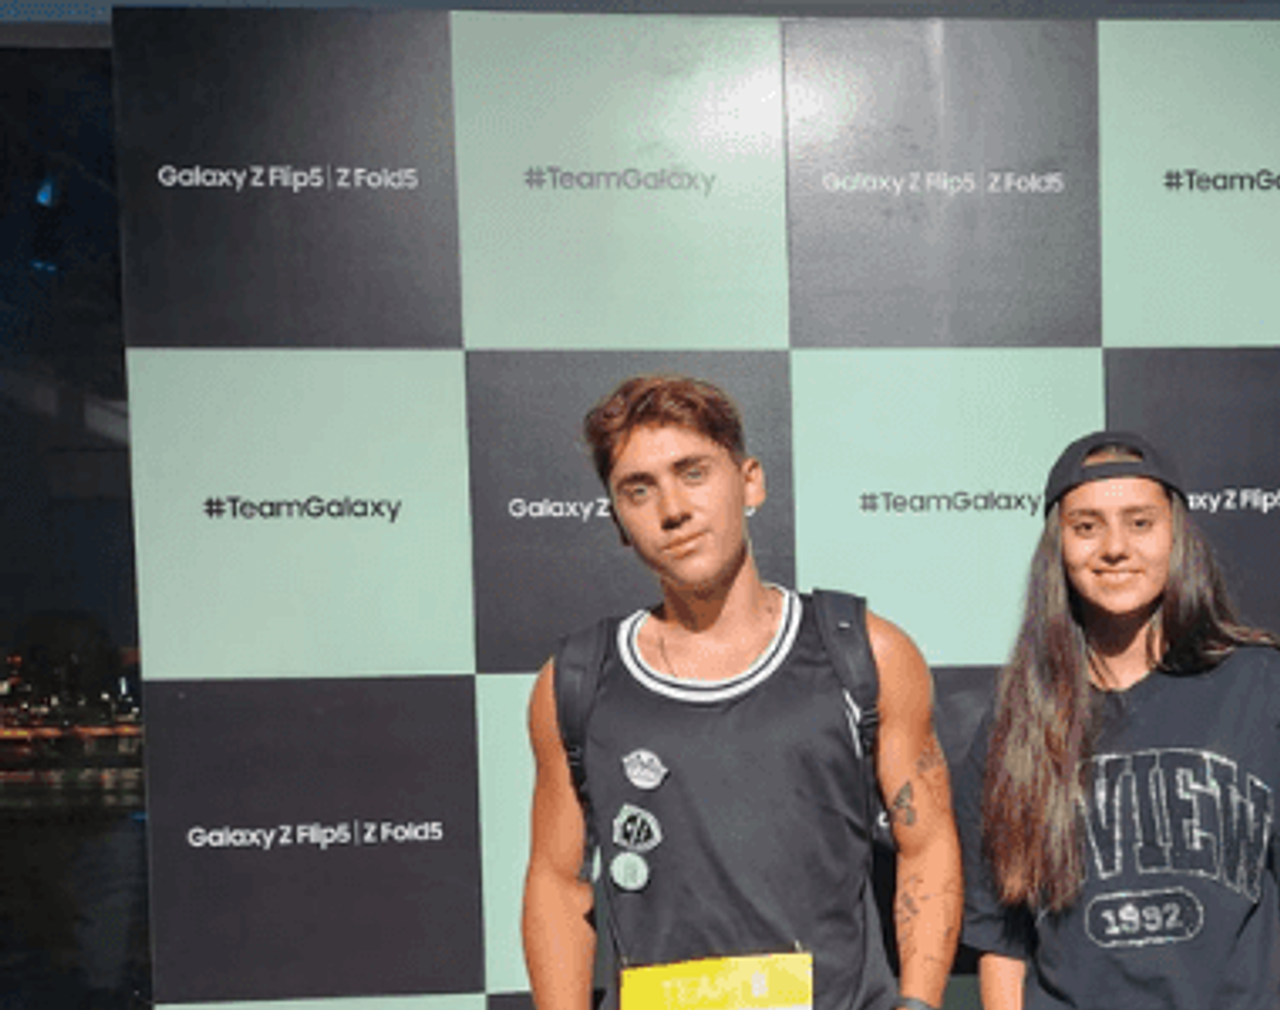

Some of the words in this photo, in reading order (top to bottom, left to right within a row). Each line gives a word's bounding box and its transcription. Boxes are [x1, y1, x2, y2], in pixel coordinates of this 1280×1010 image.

[158, 166, 247, 191] Galaxy
[251, 166, 264, 186] Z
[269, 166, 323, 192] Flip5
[337, 168, 350, 187] Z
[354, 168, 418, 189] Fold5
[525, 167, 716, 197] #TeamGalaxy
[822, 171, 905, 196] Galaxy
[909, 172, 921, 191] Z
[926, 171, 976, 195] Flip5
[988, 172, 1000, 191] Z
[1004, 171, 1064, 192] Fold5
[204, 496, 401, 522] #TeamGalaxy
[509, 498, 594, 521] Galaxy
[860, 490, 1042, 517] #TeamGalaxy
[1224, 490, 1236, 509] Z
[188, 827, 276, 849] Galaxy
[279, 825, 292, 844] Z
[297, 823, 351, 849] Flip5
[364, 823, 376, 842] Z
[381, 822, 443, 841] Fold5
[1101, 904, 1182, 936] 1992
